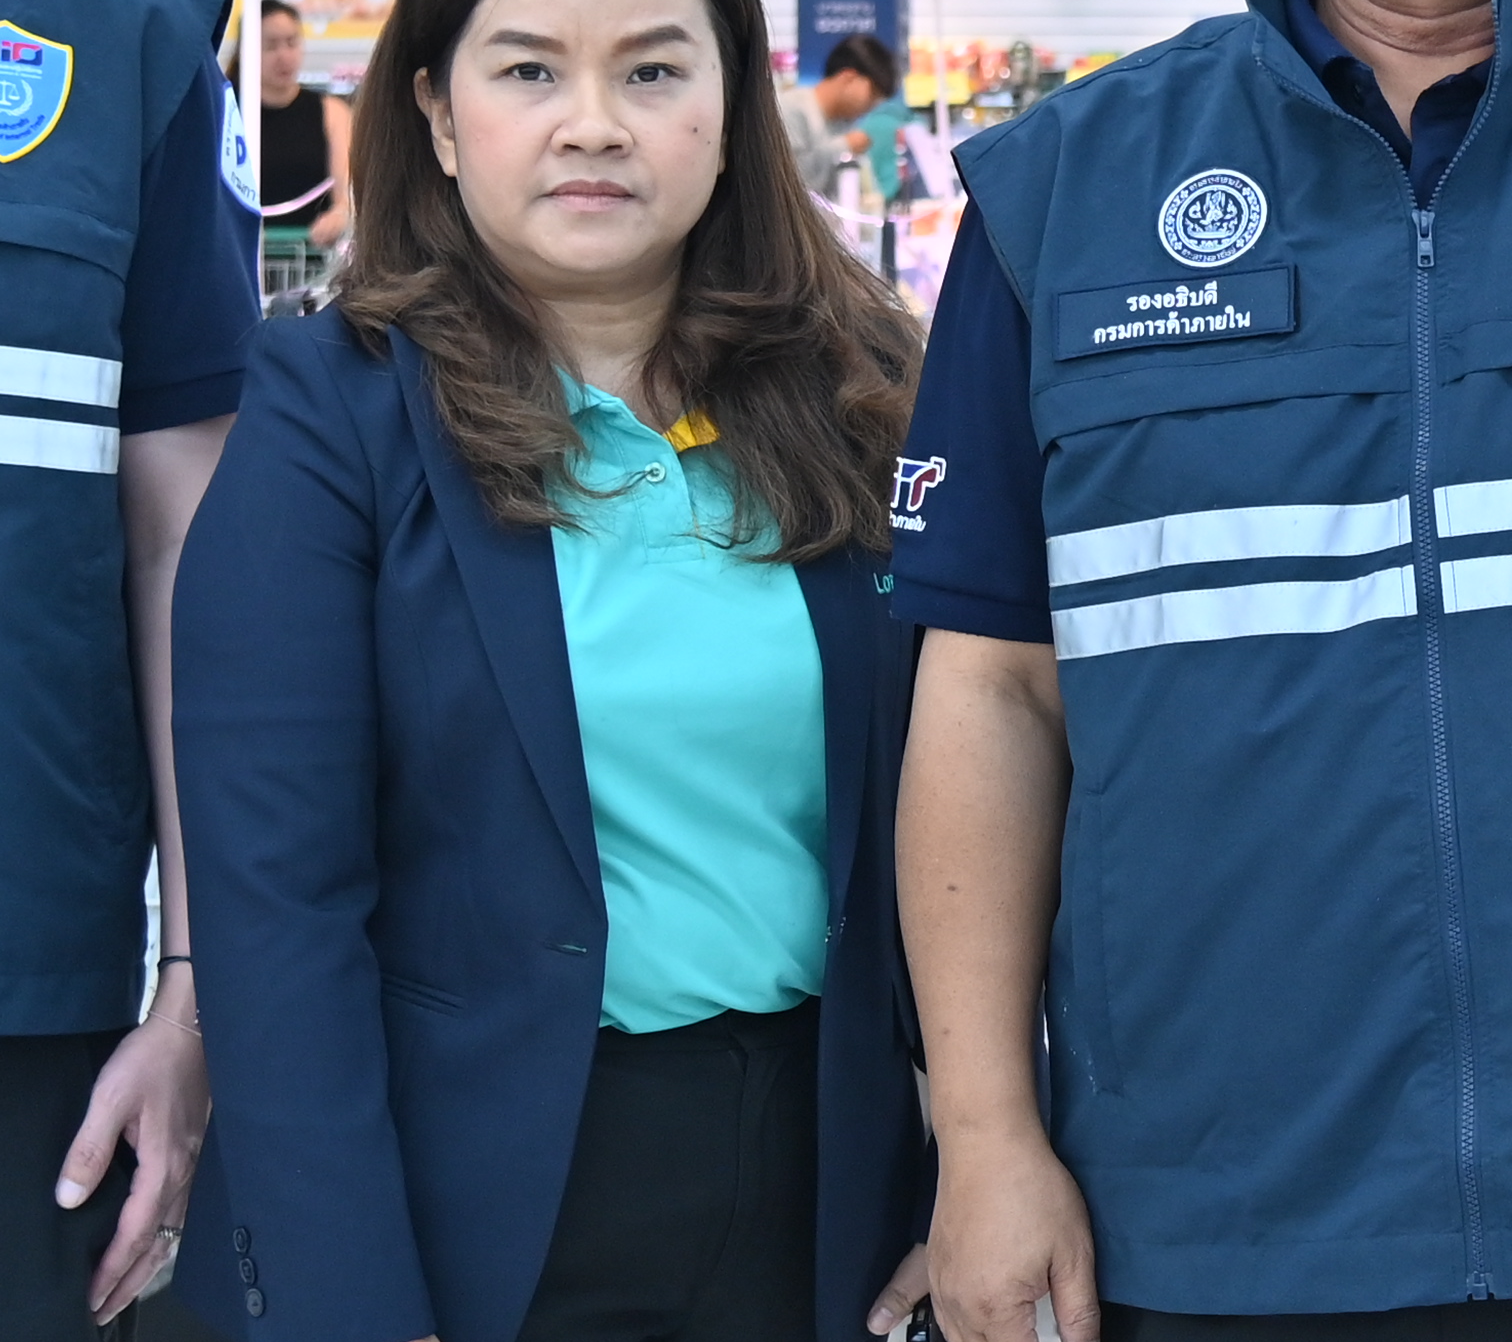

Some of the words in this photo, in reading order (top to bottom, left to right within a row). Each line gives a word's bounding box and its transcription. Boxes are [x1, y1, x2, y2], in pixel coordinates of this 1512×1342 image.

[1126, 280, 1218, 312] รองอธิบดี
[1092, 305, 1251, 344] กรมการค้าภายใน
